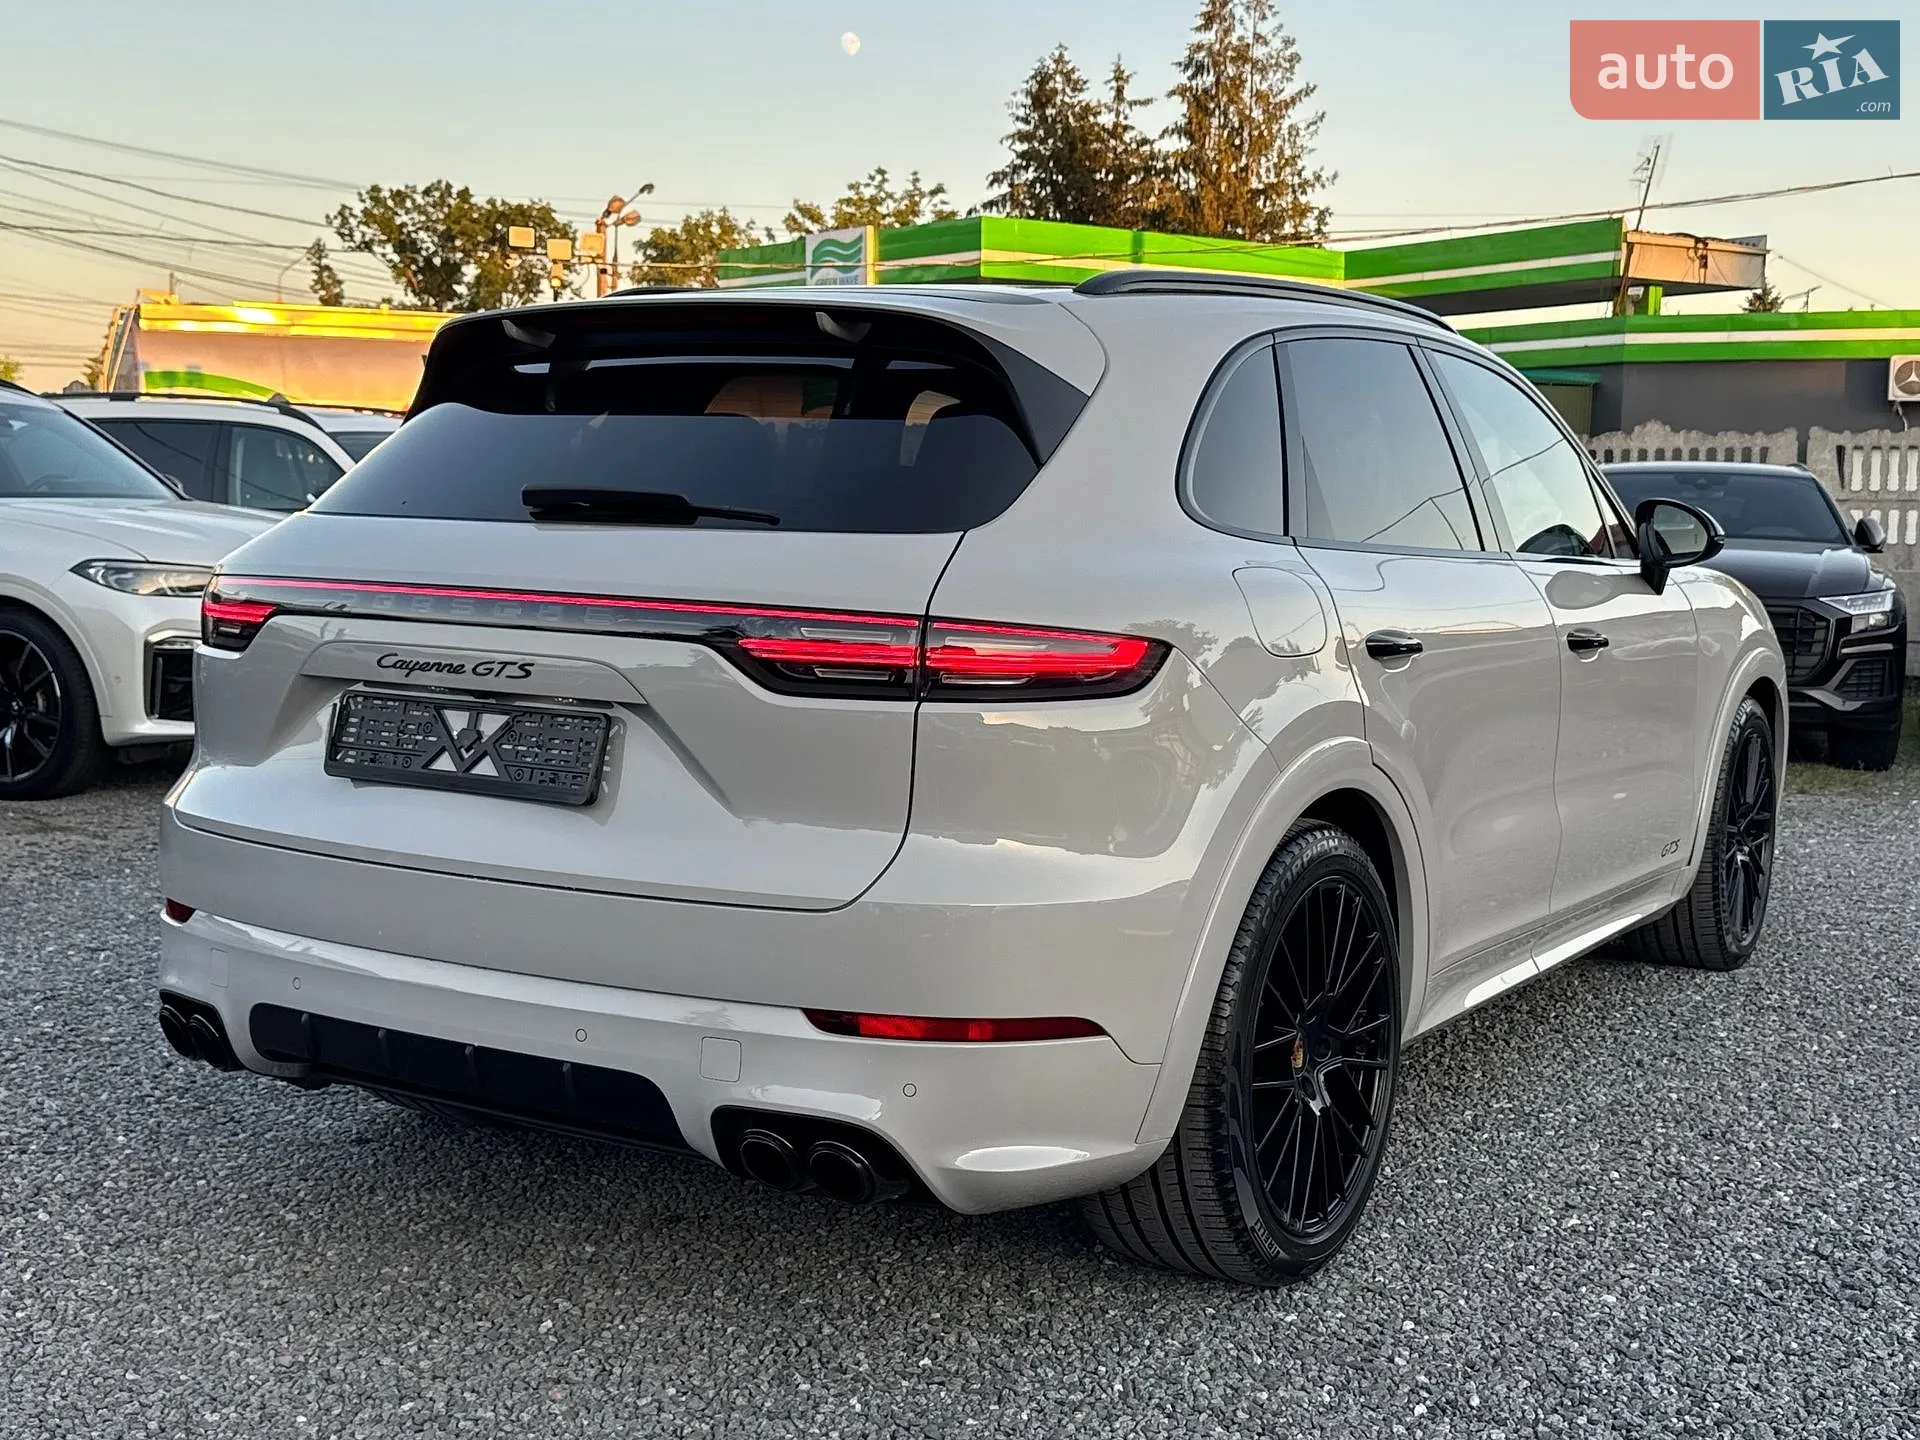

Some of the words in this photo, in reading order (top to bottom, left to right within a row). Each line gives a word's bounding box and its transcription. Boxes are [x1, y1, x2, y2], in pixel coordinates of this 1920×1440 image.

[376, 652, 466, 678] Cayenne
[471, 660, 535, 679] GTS
[1661, 838, 1681, 858] GTS
